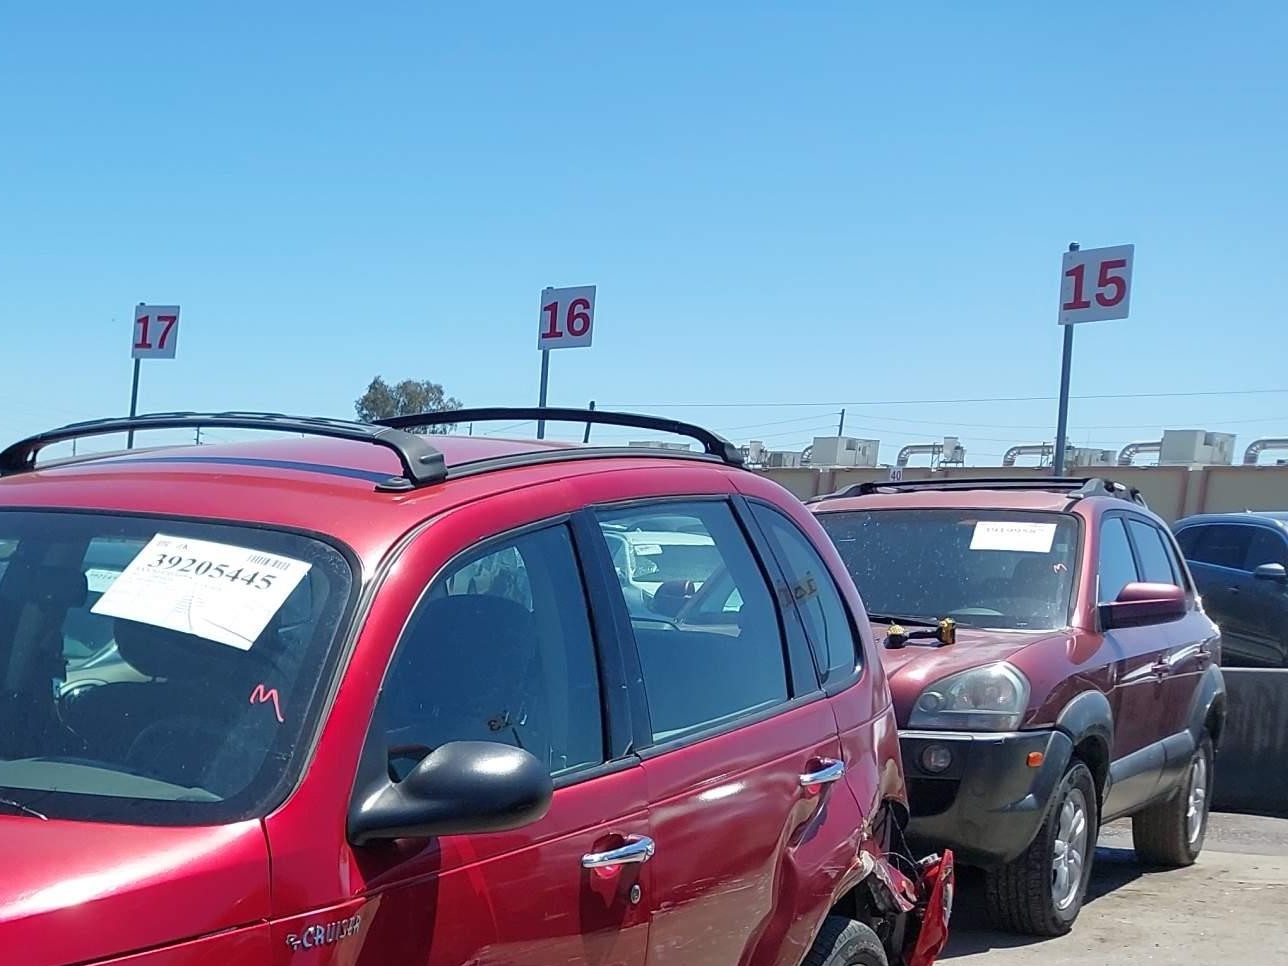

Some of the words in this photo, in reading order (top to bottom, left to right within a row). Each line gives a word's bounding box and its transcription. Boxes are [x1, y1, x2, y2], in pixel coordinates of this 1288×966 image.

[1063, 259, 1128, 312] 15
[134, 315, 177, 349] 17
[542, 297, 592, 341] 16
[890, 469, 902, 481] 40
[147, 553, 278, 591] 39205445
[302, 914, 362, 949] CRUISER
